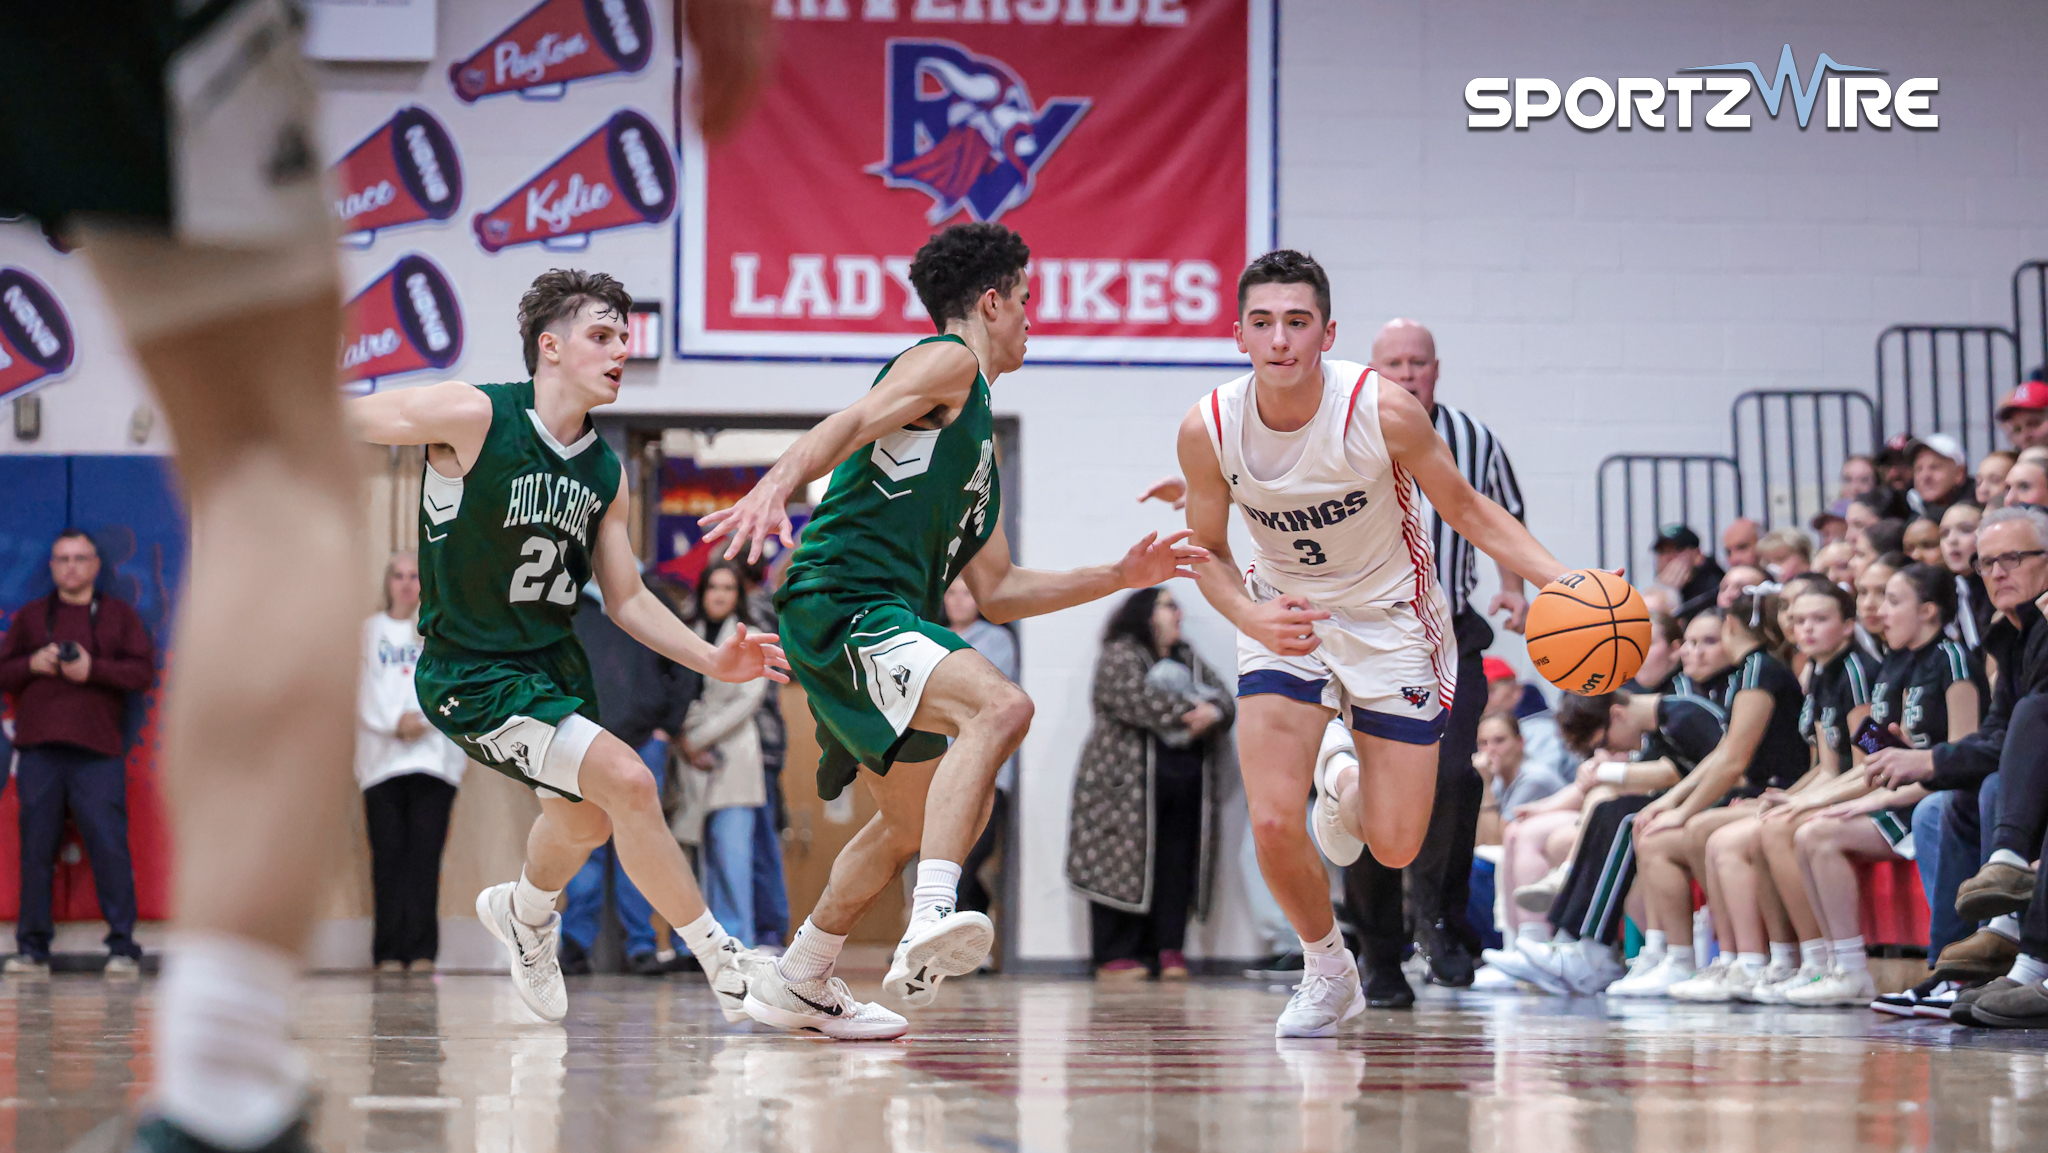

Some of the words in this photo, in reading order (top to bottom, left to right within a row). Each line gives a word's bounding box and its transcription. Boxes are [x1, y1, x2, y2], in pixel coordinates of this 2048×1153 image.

[526, 172, 613, 233] Kylie
[731, 253, 930, 322] LADY
[1026, 257, 1222, 325] IKES
[1292, 538, 1327, 566] 3
